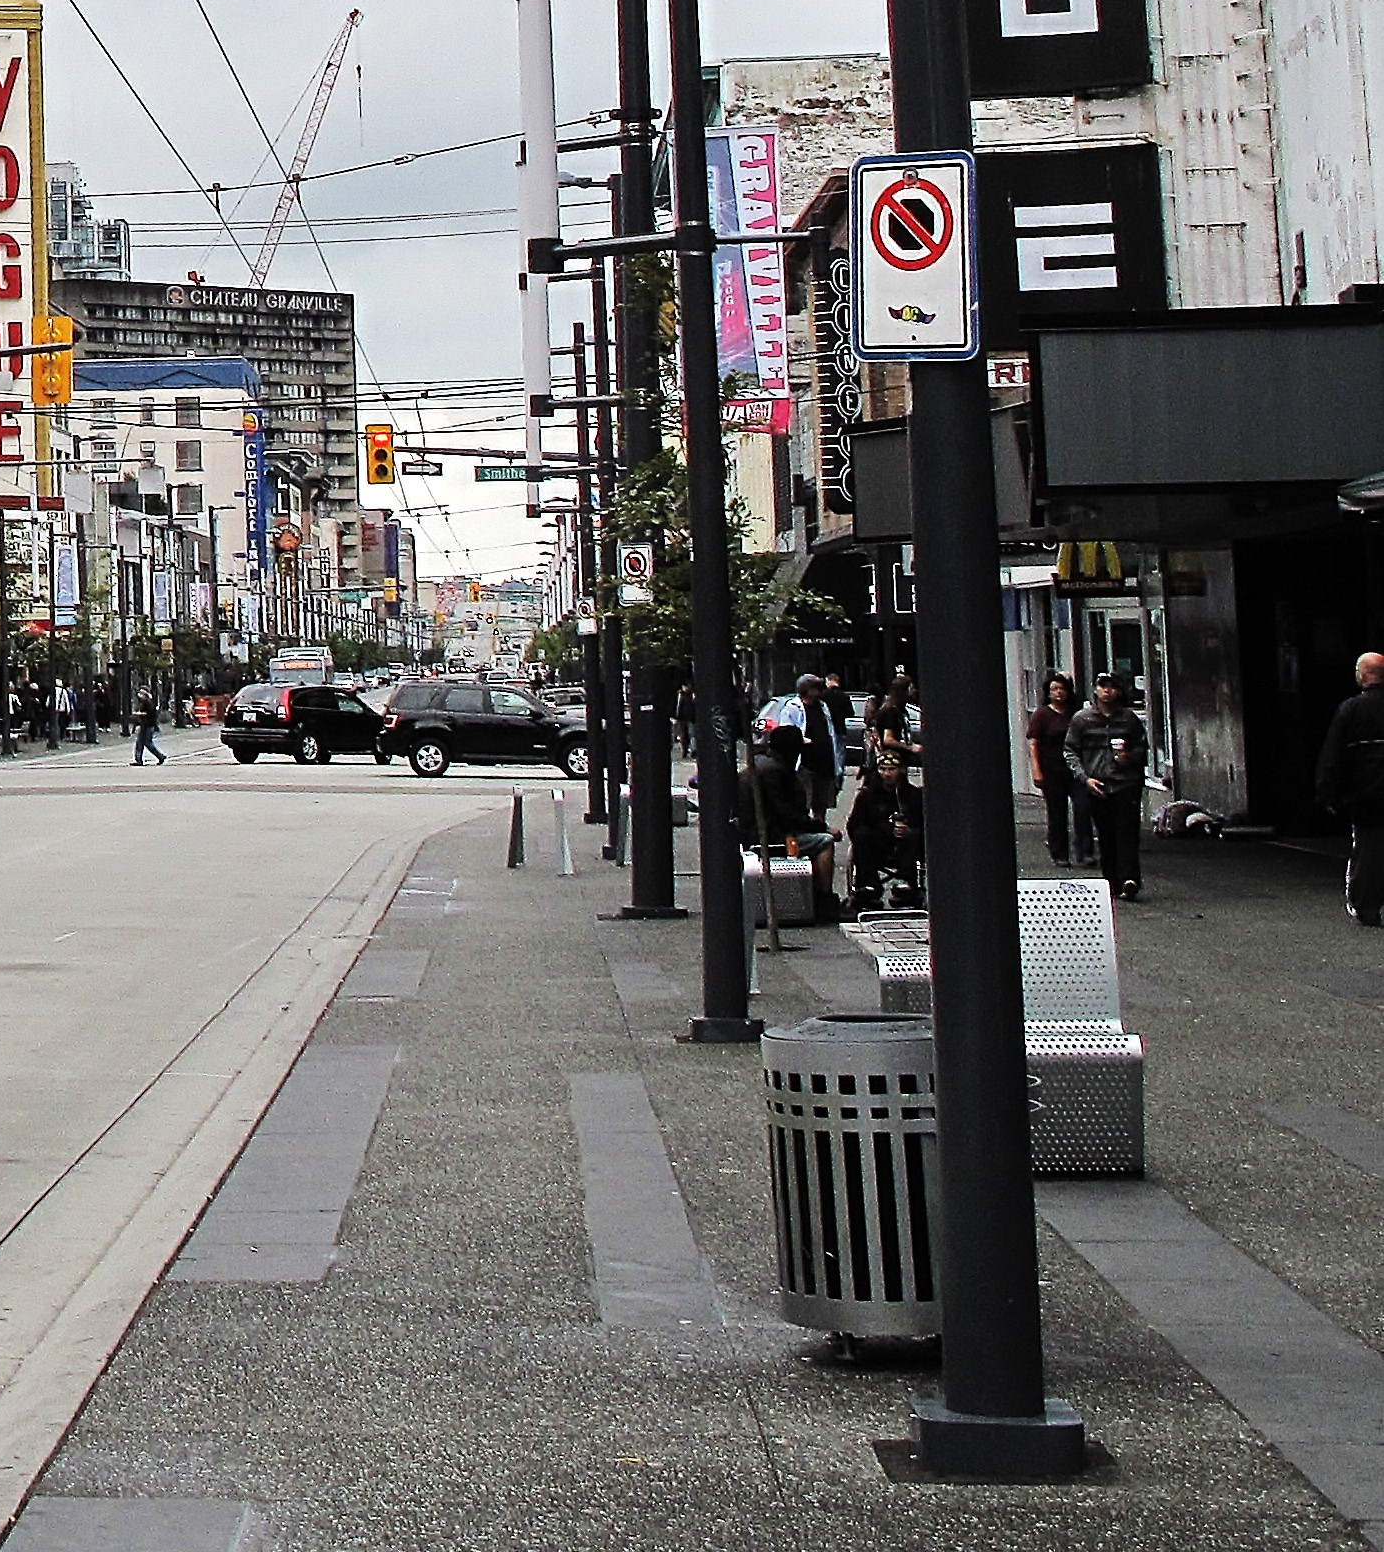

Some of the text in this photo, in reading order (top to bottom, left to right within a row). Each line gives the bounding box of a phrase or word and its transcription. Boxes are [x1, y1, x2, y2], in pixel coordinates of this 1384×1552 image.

[190, 289, 344, 314] CHATEAU GRANVILLE
[484, 467, 526, 480] Smithe
[245, 442, 258, 532] Comfort
